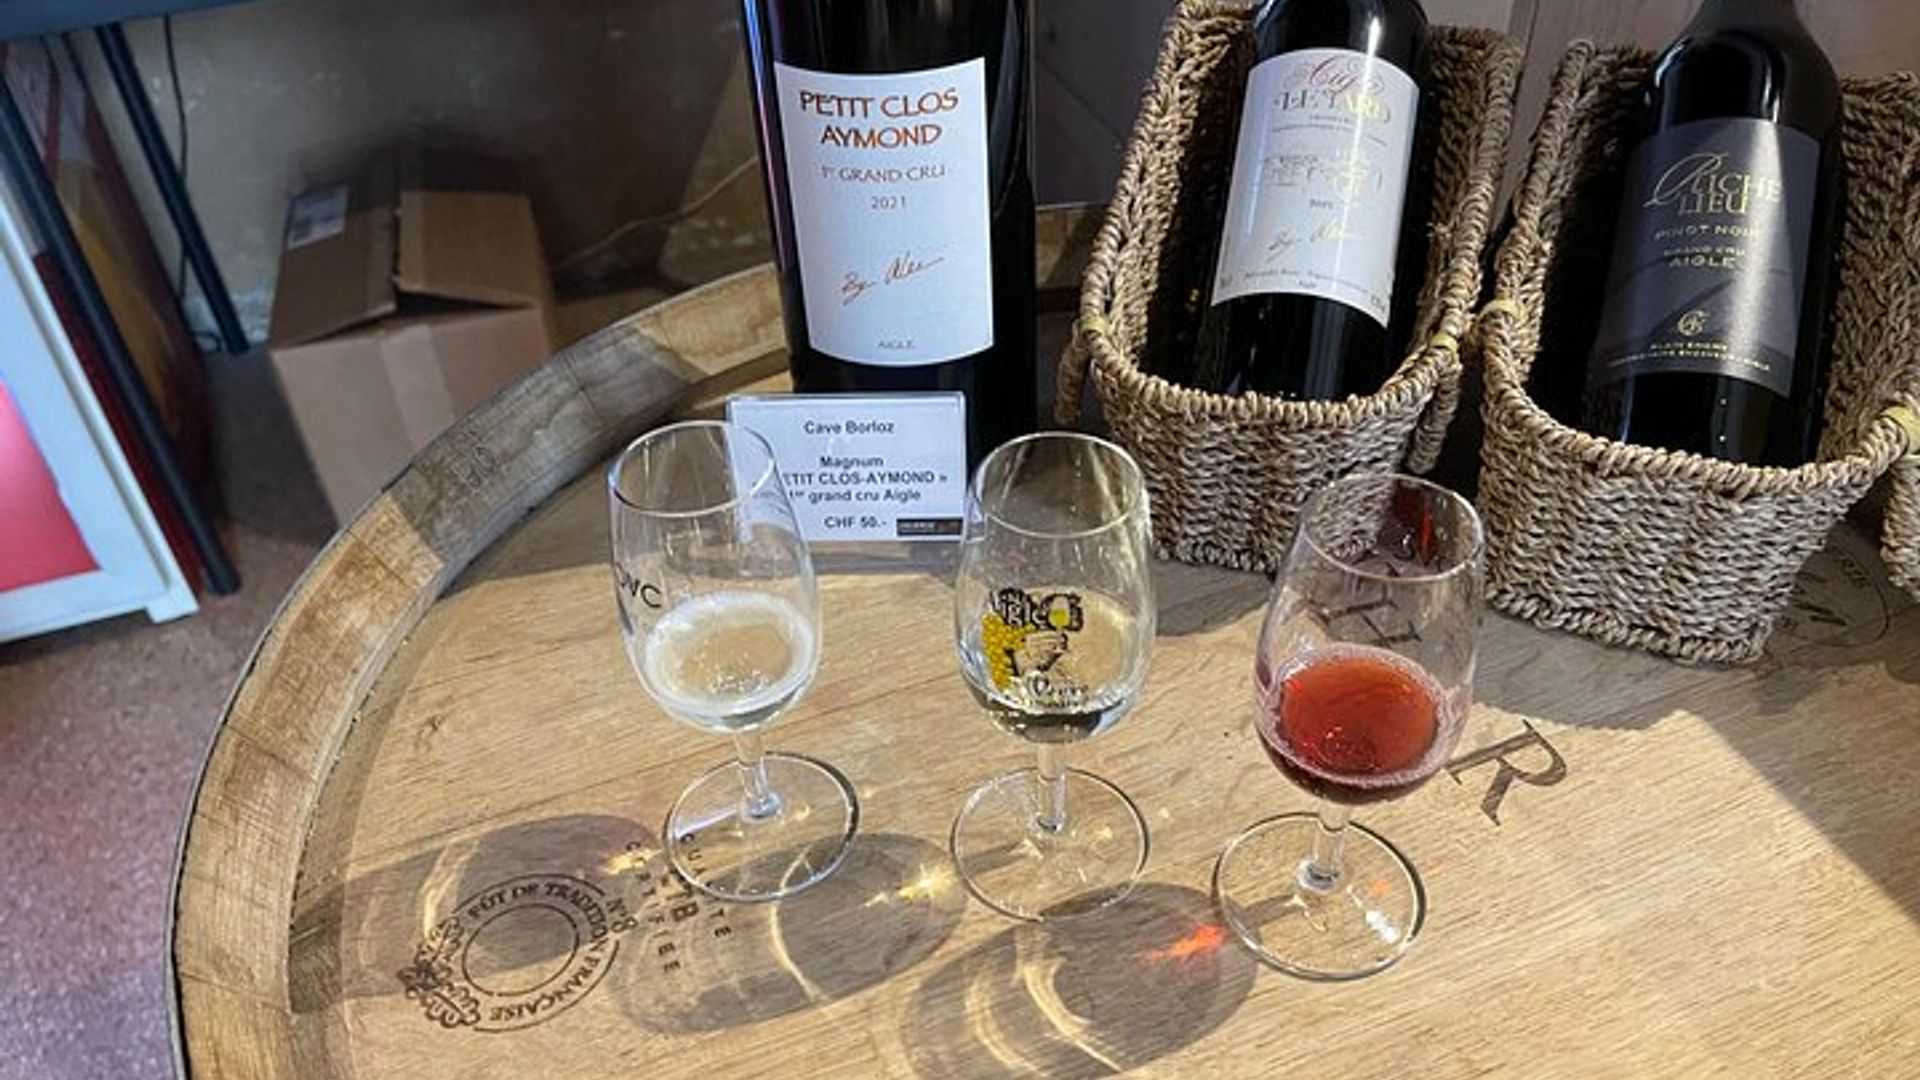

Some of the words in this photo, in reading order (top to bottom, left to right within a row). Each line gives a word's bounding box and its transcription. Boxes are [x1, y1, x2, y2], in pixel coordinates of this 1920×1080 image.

[800, 90, 874, 119] PETIT
[881, 87, 959, 118] CLOS
[820, 124, 942, 149] AYMOND
[840, 166, 902, 183] GRAND
[907, 164, 946, 182] CRU
[871, 196, 907, 210] 2021
[1655, 224, 1711, 241] PINOT
[1669, 256, 1738, 269] AIGLE
[878, 339, 915, 350] AIGLE
[804, 420, 842, 434] Cave
[845, 420, 895, 434] Borloz
[820, 456, 884, 469] Magnum
[818, 472, 935, 486] CLOS-AYMOND
[808, 490, 851, 504] grand
[855, 492, 879, 501] cru
[883, 490, 921, 504] Aigle
[824, 516, 855, 529] CHF
[860, 516, 887, 529] 50.-
[511, 882, 541, 899] DE
[545, 881, 609, 951] TRADITION
